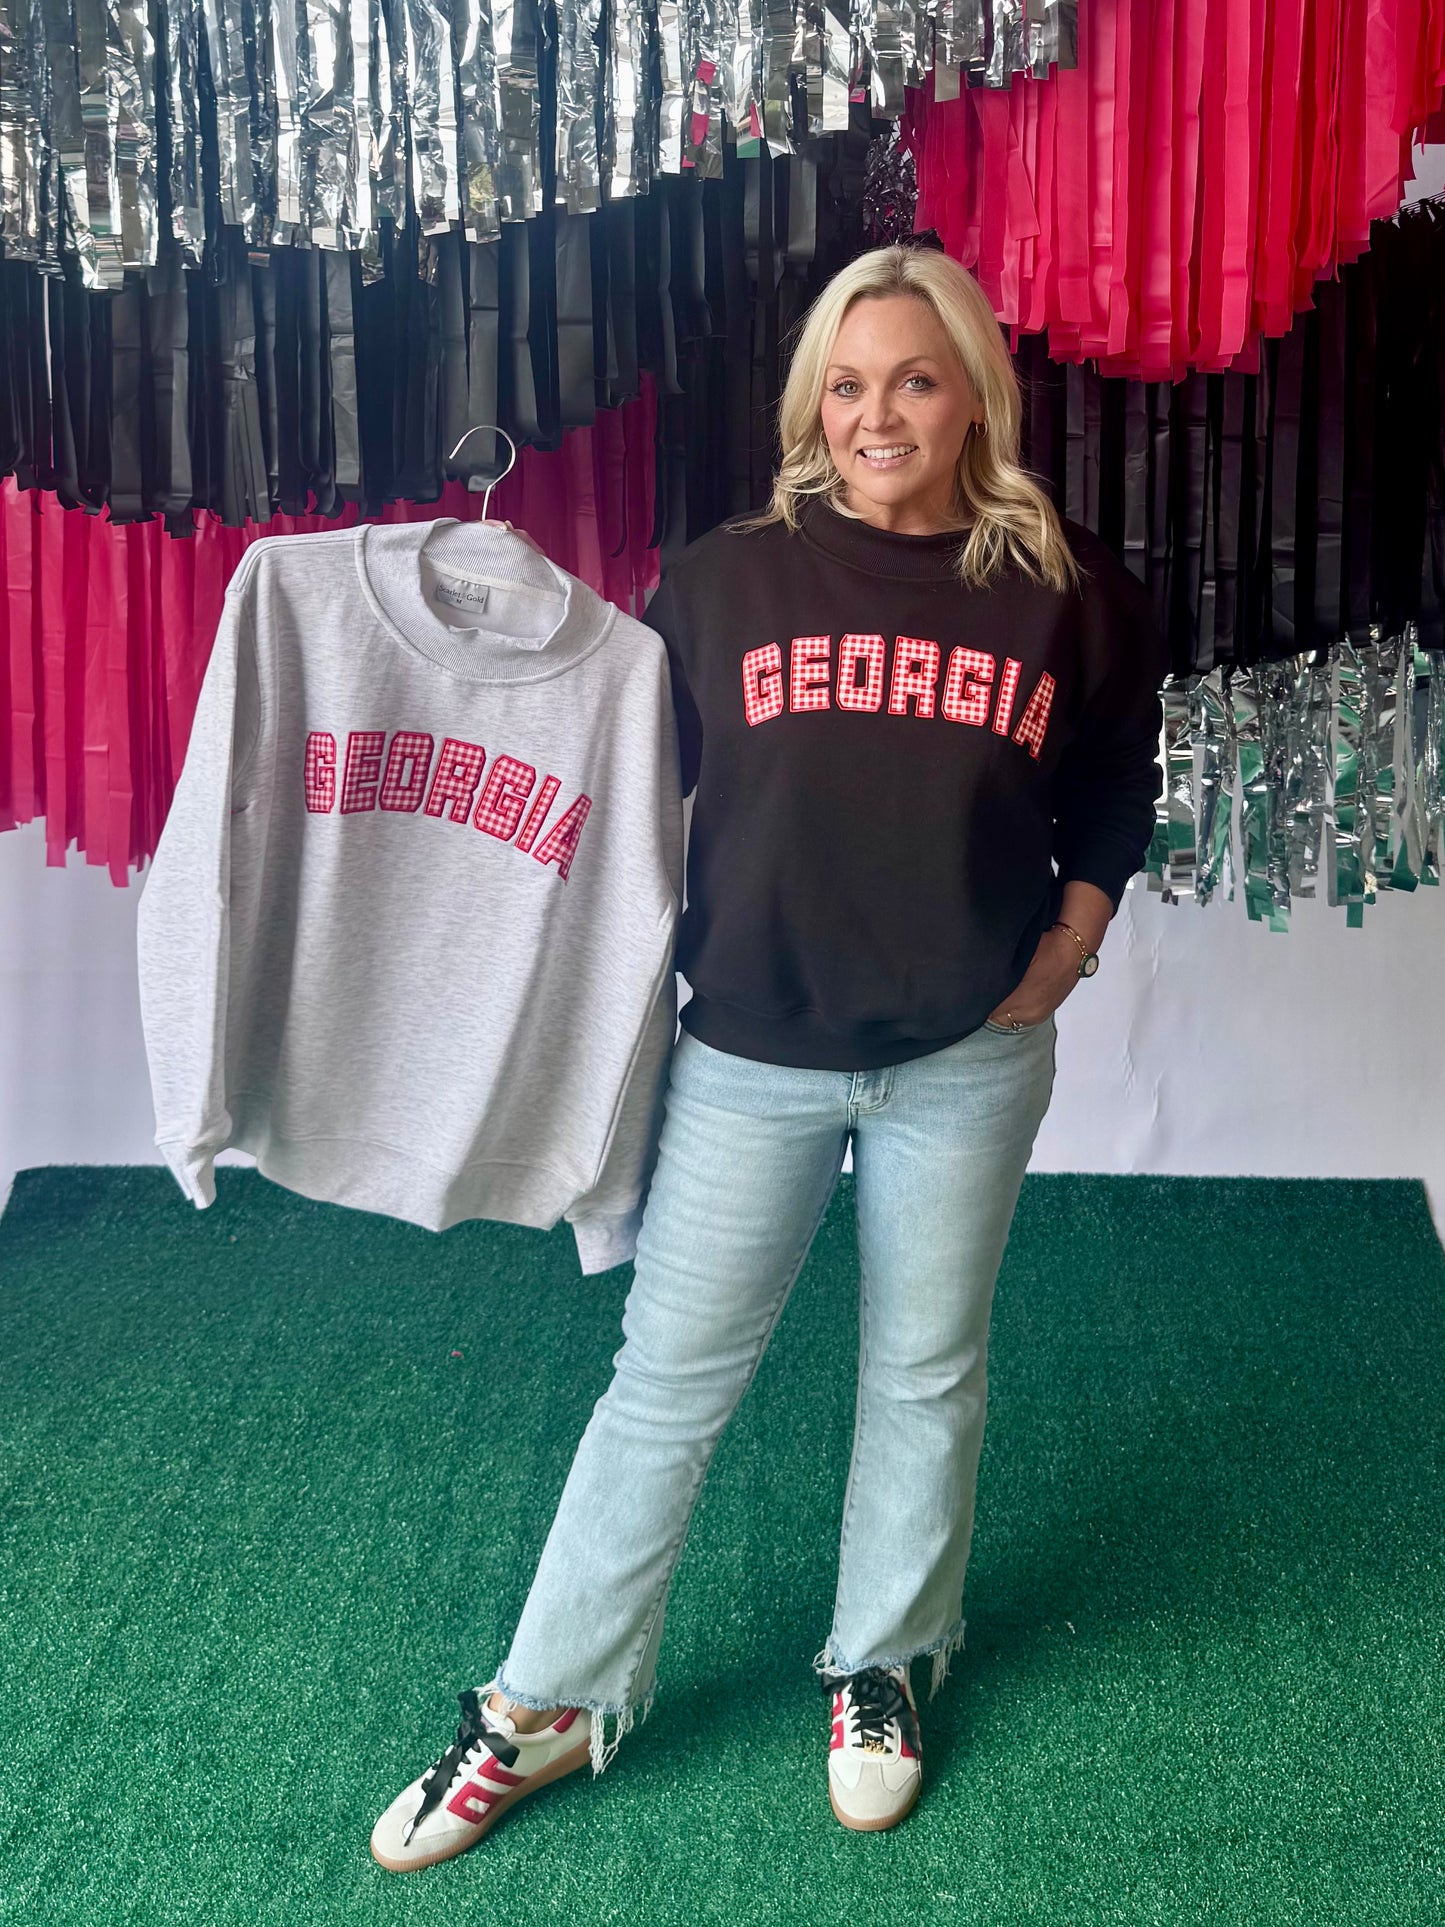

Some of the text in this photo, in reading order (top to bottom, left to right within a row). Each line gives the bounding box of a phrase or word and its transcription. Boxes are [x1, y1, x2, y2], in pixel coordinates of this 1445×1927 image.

[439, 584, 461, 598] Scarlet
[466, 593, 485, 604] Gold
[742, 632, 1057, 761] GEORGIA
[304, 731, 593, 884] GEORGIA
